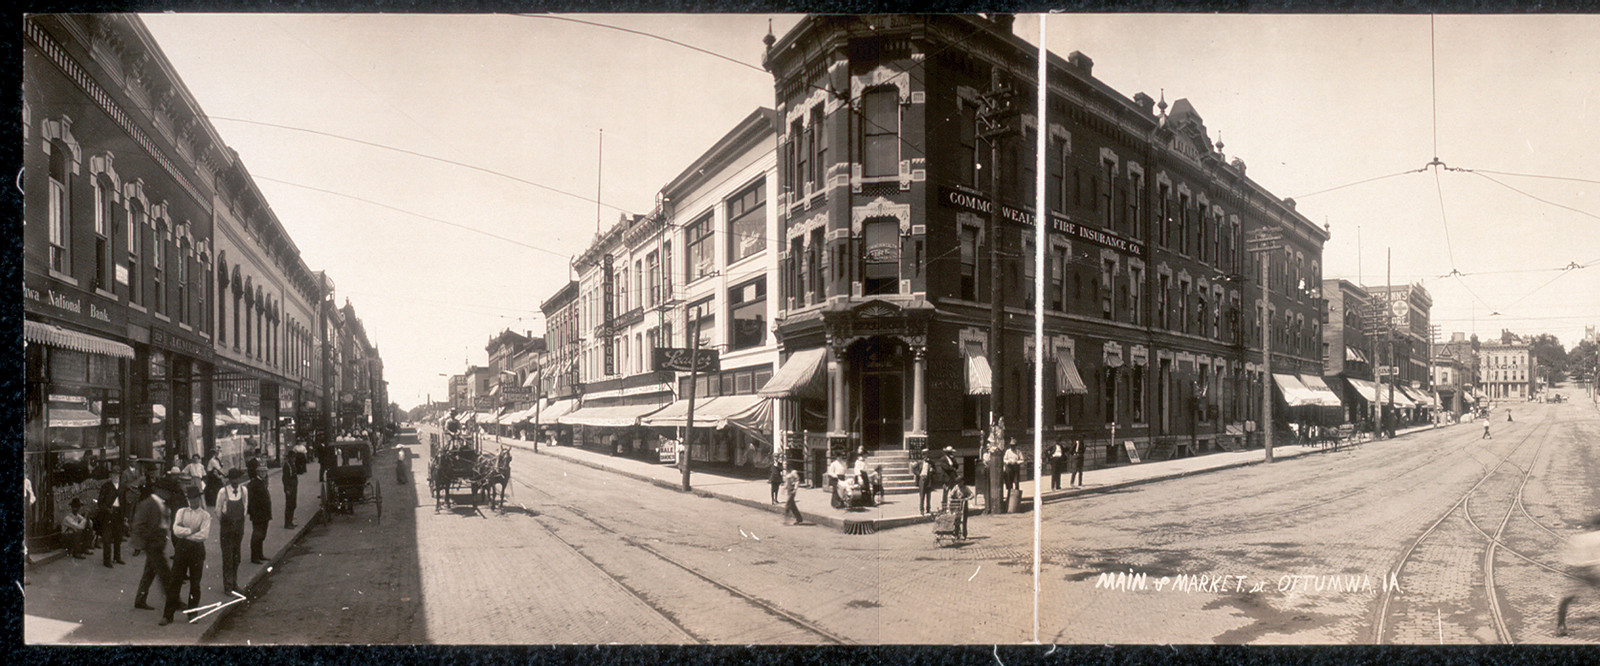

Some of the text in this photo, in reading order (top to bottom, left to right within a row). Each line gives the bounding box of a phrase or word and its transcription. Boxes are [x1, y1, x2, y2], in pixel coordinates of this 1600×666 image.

[1053, 218, 1076, 235] FIRE
[1079, 226, 1127, 251] INSURANCE
[48, 289, 80, 314] National
[605, 275, 613, 321] LOUIS
[605, 327, 613, 374] STORE
